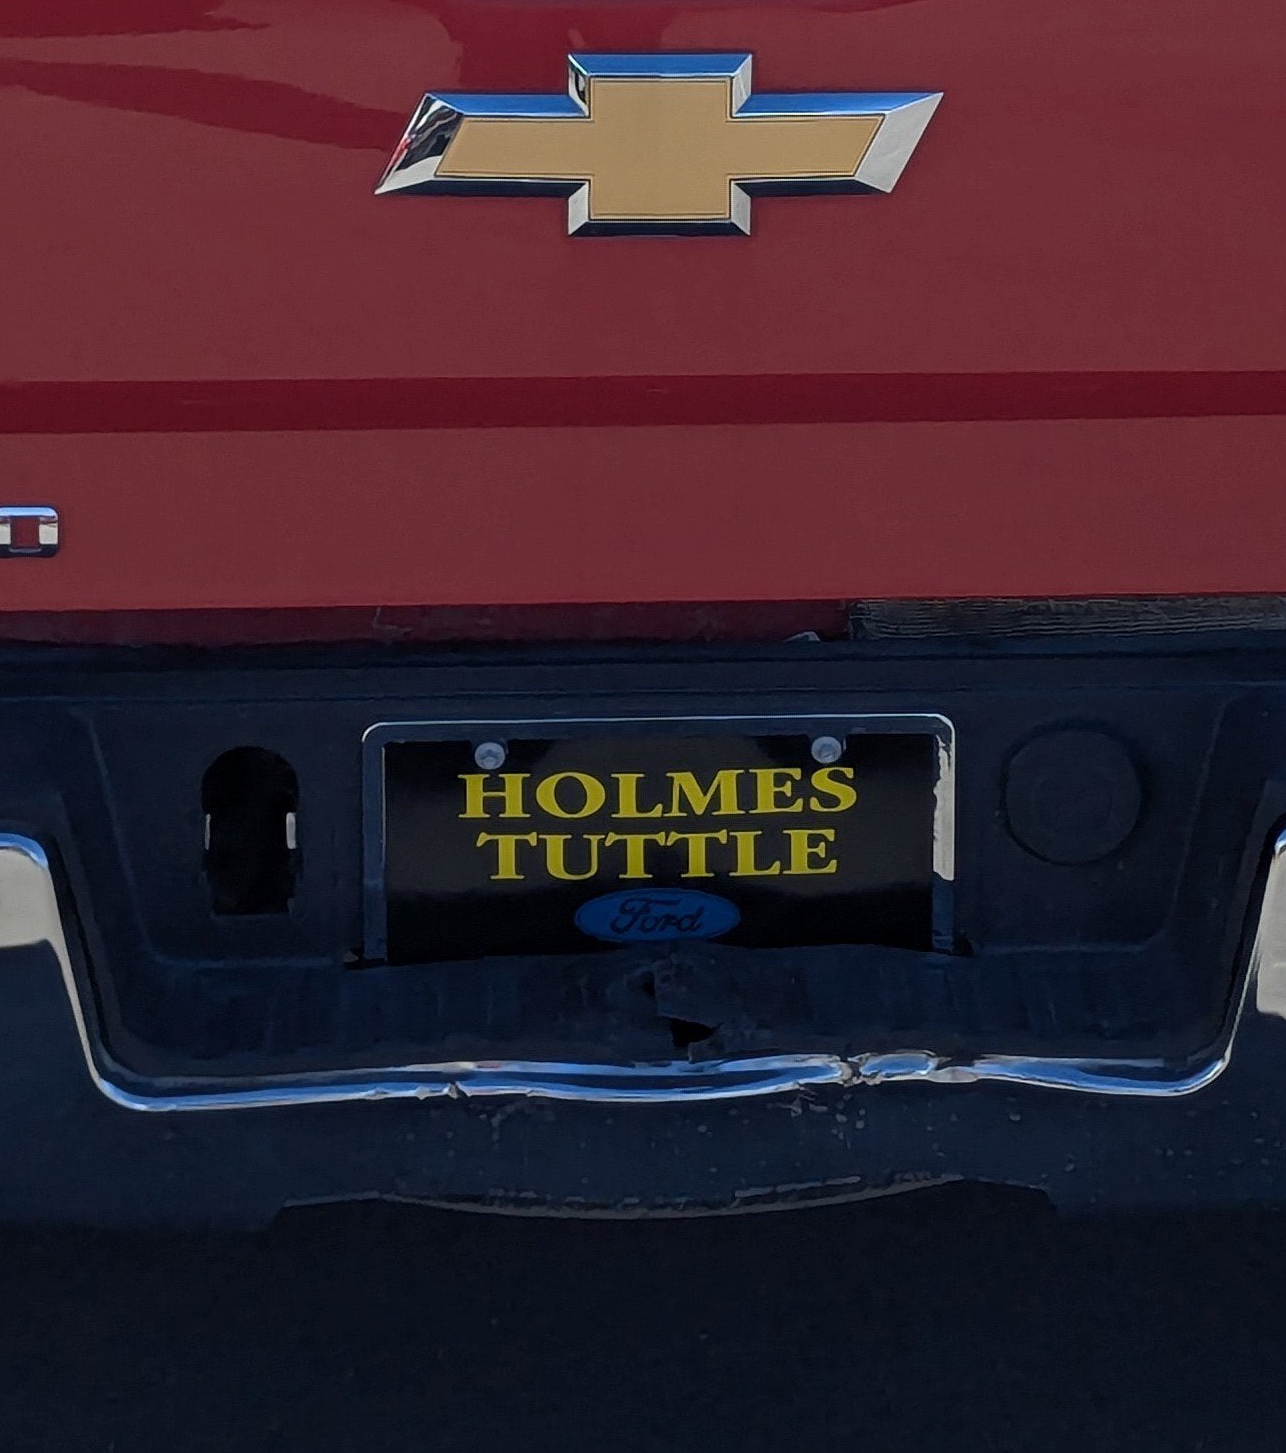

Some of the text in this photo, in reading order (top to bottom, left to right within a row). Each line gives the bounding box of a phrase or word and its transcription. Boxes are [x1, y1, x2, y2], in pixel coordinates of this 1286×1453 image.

[457, 766, 859, 819] HOLMES
[476, 828, 839, 881] TUTTLE
[610, 896, 705, 935] Ford
